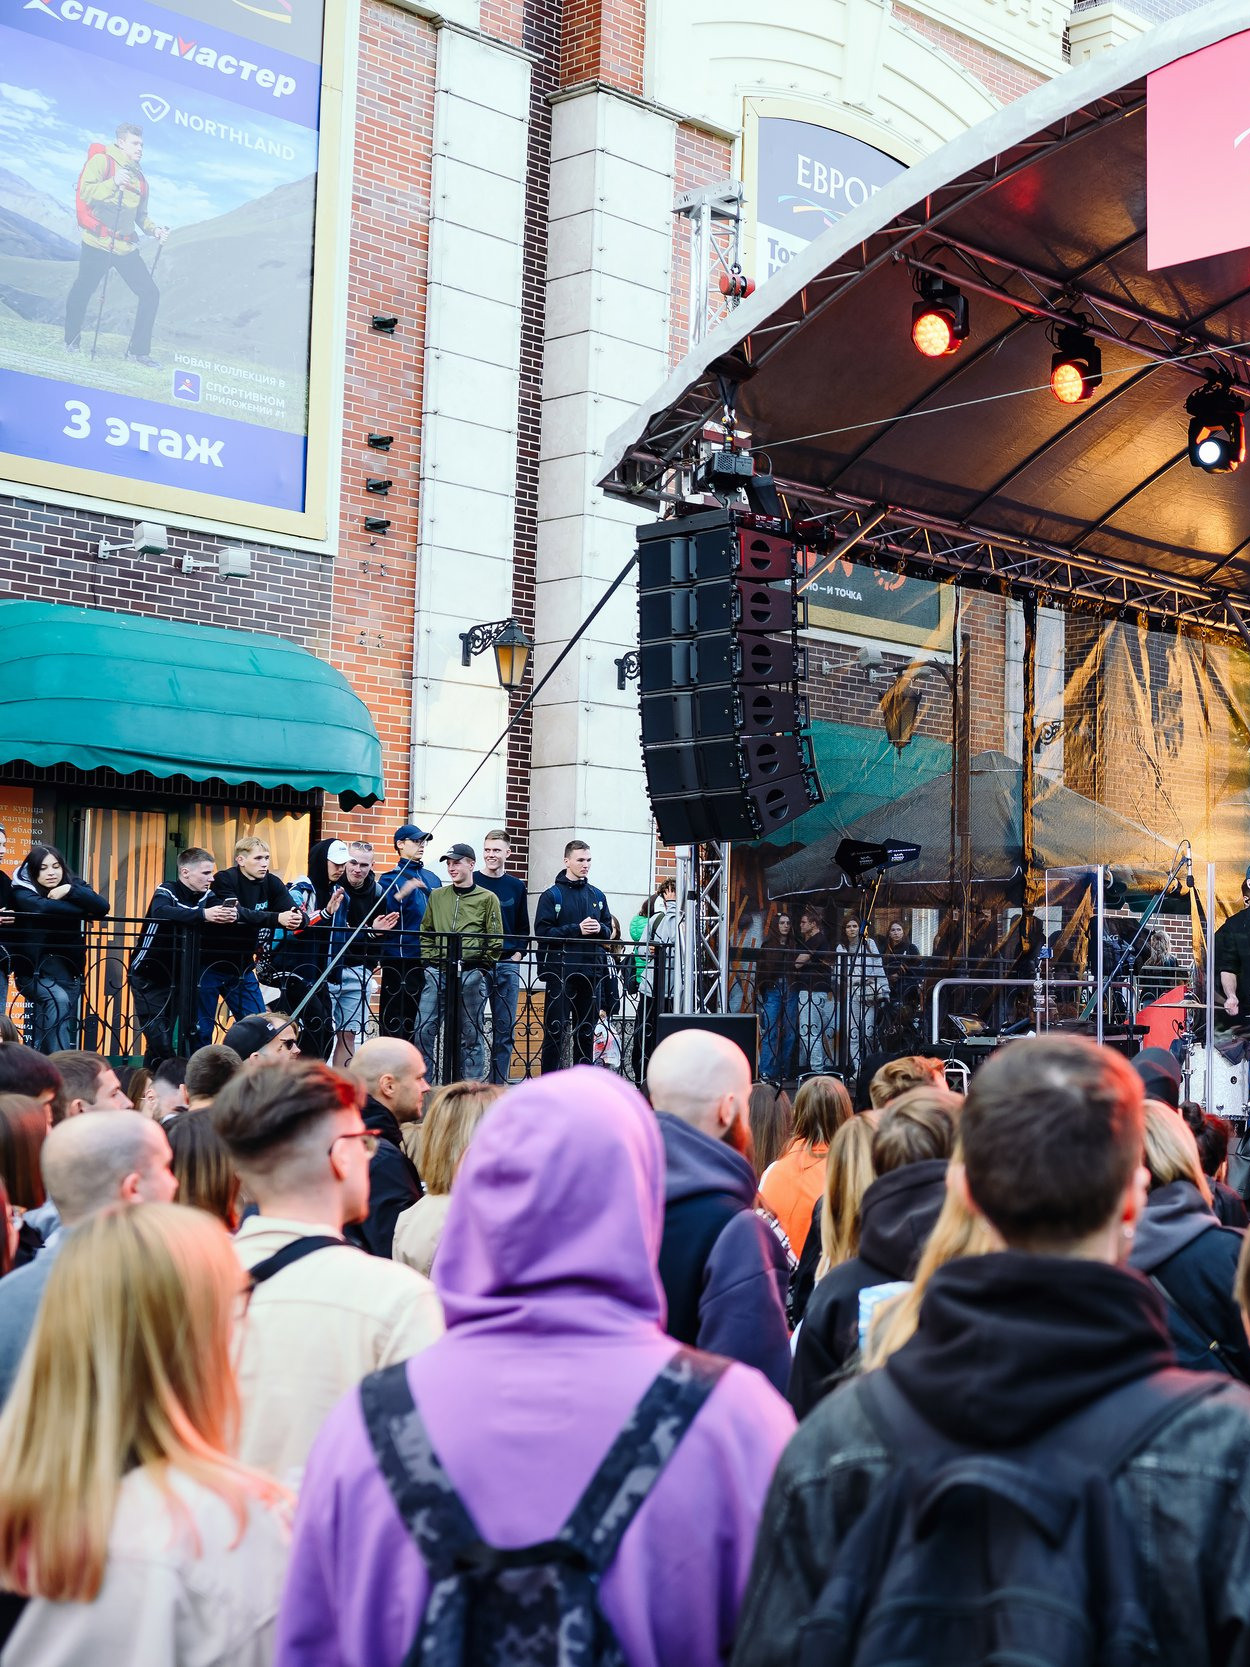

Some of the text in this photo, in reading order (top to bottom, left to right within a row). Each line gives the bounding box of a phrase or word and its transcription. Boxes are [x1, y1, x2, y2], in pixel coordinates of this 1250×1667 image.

[174, 109, 296, 161] NORTHLAND
[174, 353, 286, 388] НОВАЯ КОЛЛЕКЦИЯ В
[205, 393, 273, 416] ПРИЛОЖЕНИИ
[206, 381, 285, 408] СПОРТИВНОМ
[62, 400, 225, 468] 3 этаж
[834, 588, 862, 601] ТОЧКА
[13, 805, 44, 814] курица
[13, 825, 43, 835] яблоко
